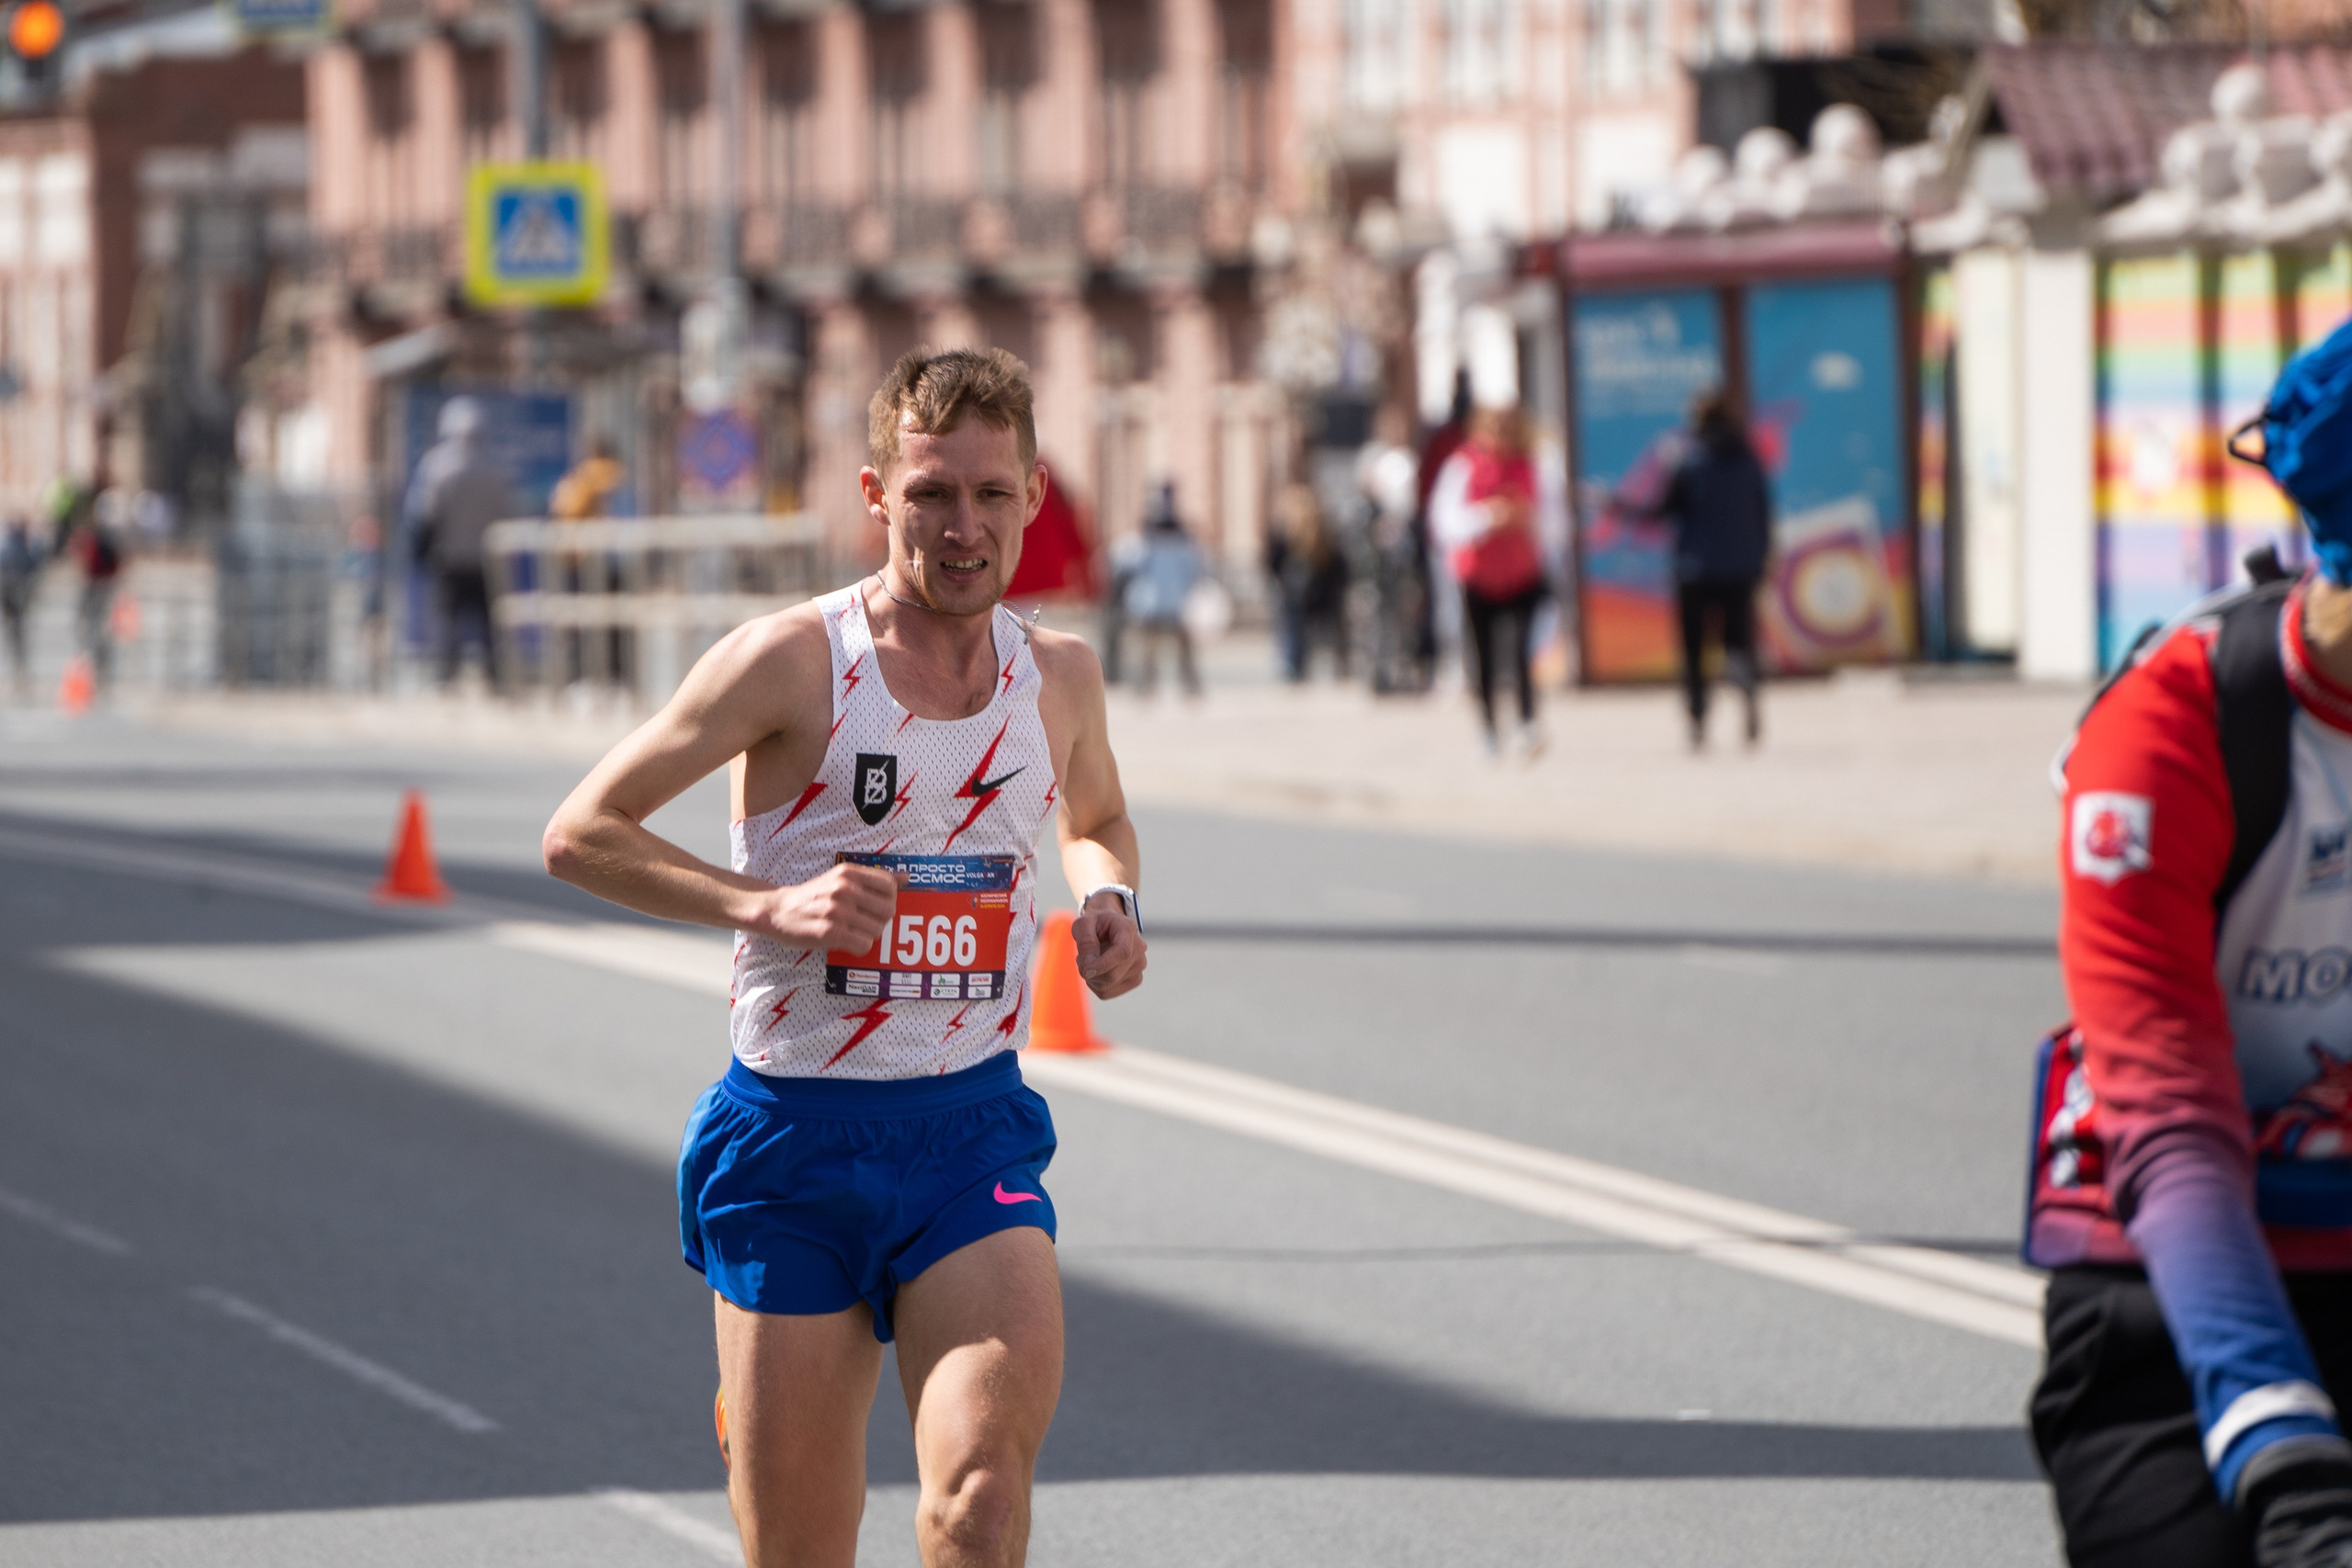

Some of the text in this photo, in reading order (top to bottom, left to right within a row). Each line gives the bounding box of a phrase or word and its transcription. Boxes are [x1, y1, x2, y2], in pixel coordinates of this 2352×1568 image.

[909, 864, 966, 873] ПРОСТО
[908, 873, 966, 884] ОСМОС
[879, 915, 978, 966] 1566
